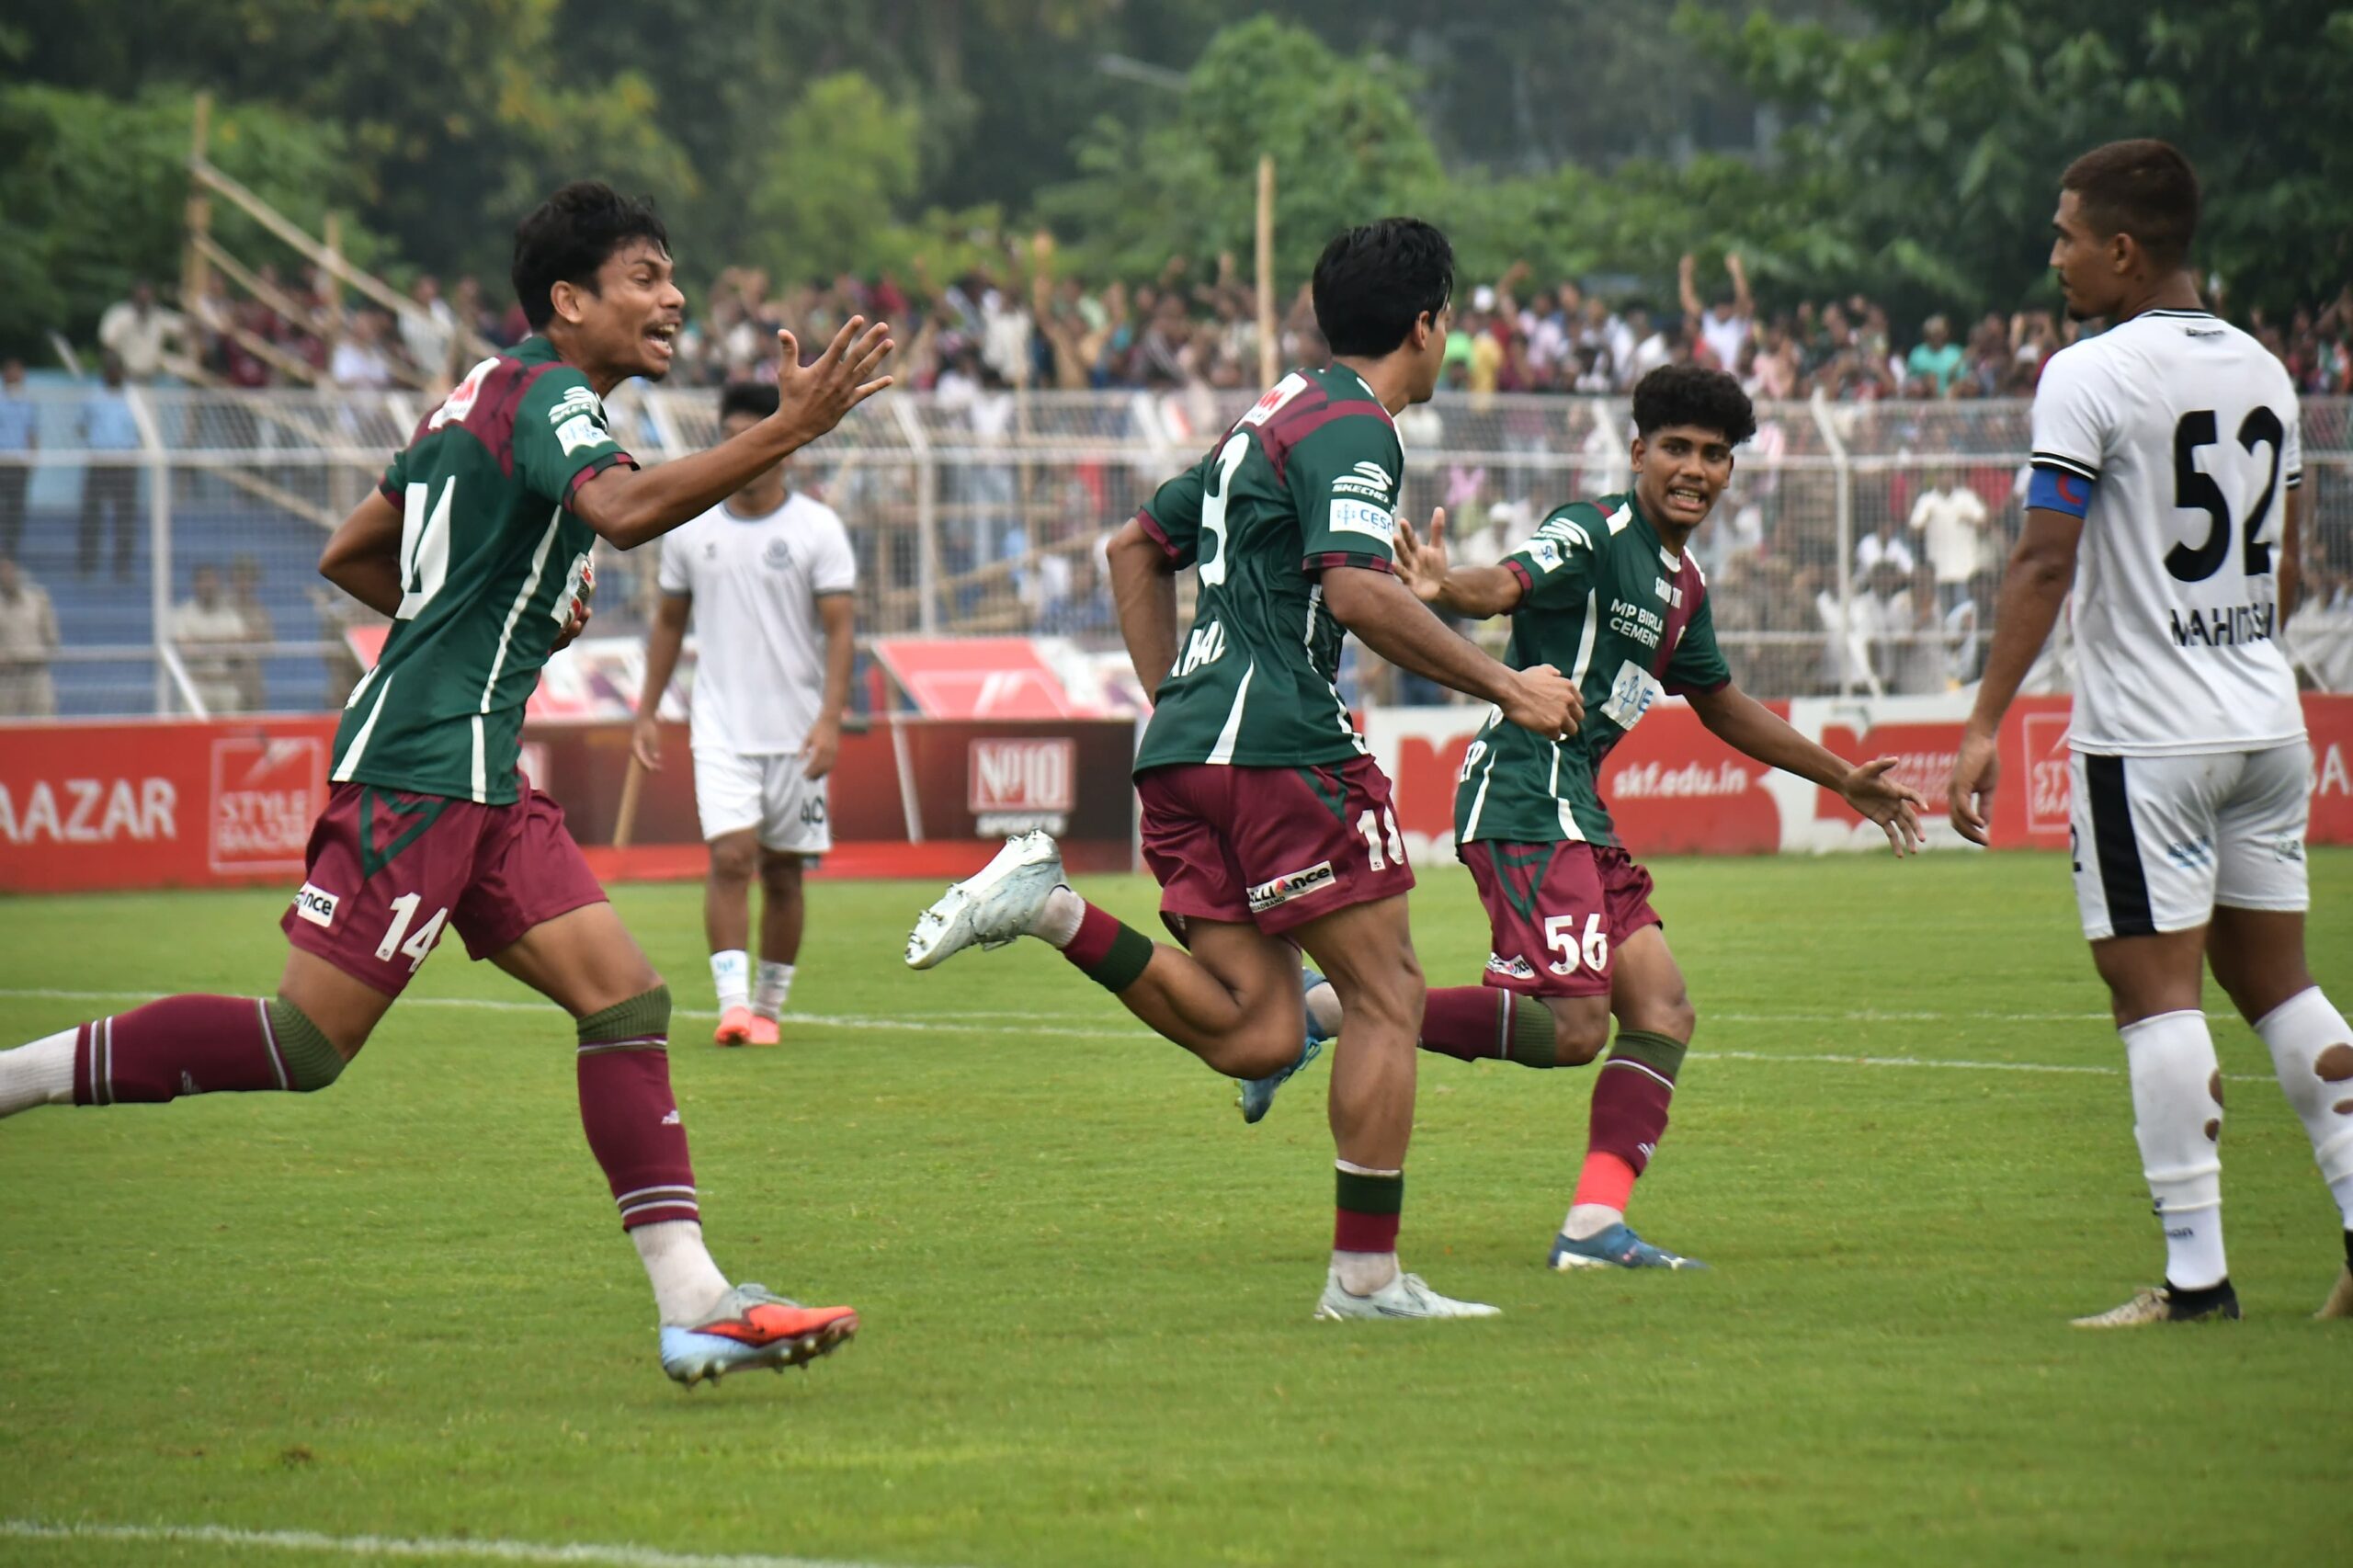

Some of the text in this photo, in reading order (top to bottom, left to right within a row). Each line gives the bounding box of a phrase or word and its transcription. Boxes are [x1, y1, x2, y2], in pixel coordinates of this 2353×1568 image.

[2164, 405, 2284, 582] 52
[1609, 617, 1659, 649] CEMENT
[1610, 597, 1637, 618] MP
[1612, 759, 1749, 799] skf.edu.in
[374, 892, 449, 973] 14
[1544, 914, 1608, 976] 56
